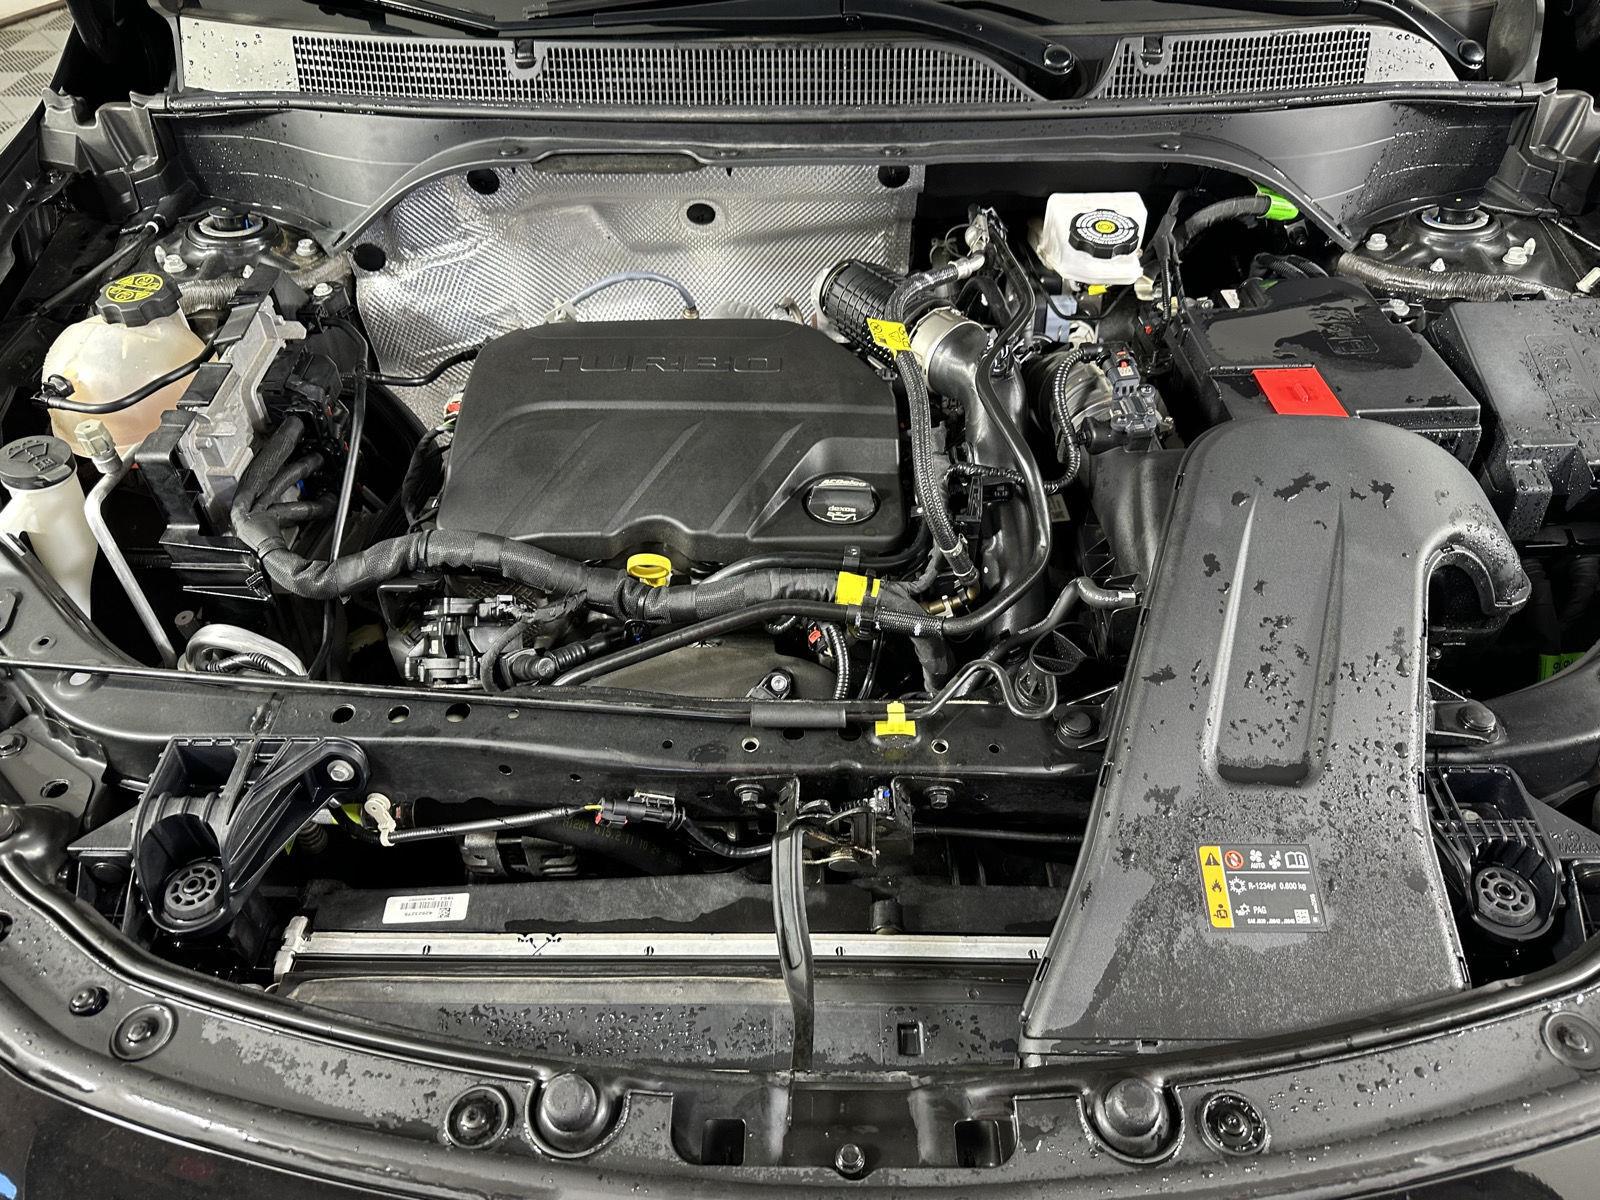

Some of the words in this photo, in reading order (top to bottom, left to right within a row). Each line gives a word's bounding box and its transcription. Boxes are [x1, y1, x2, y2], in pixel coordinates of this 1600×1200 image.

[531, 356, 782, 373] TURBO
[818, 479, 867, 487] ACDelco
[828, 505, 857, 513] dexos
[1298, 882, 1307, 892] kg
[1252, 906, 1268, 915] PAG
